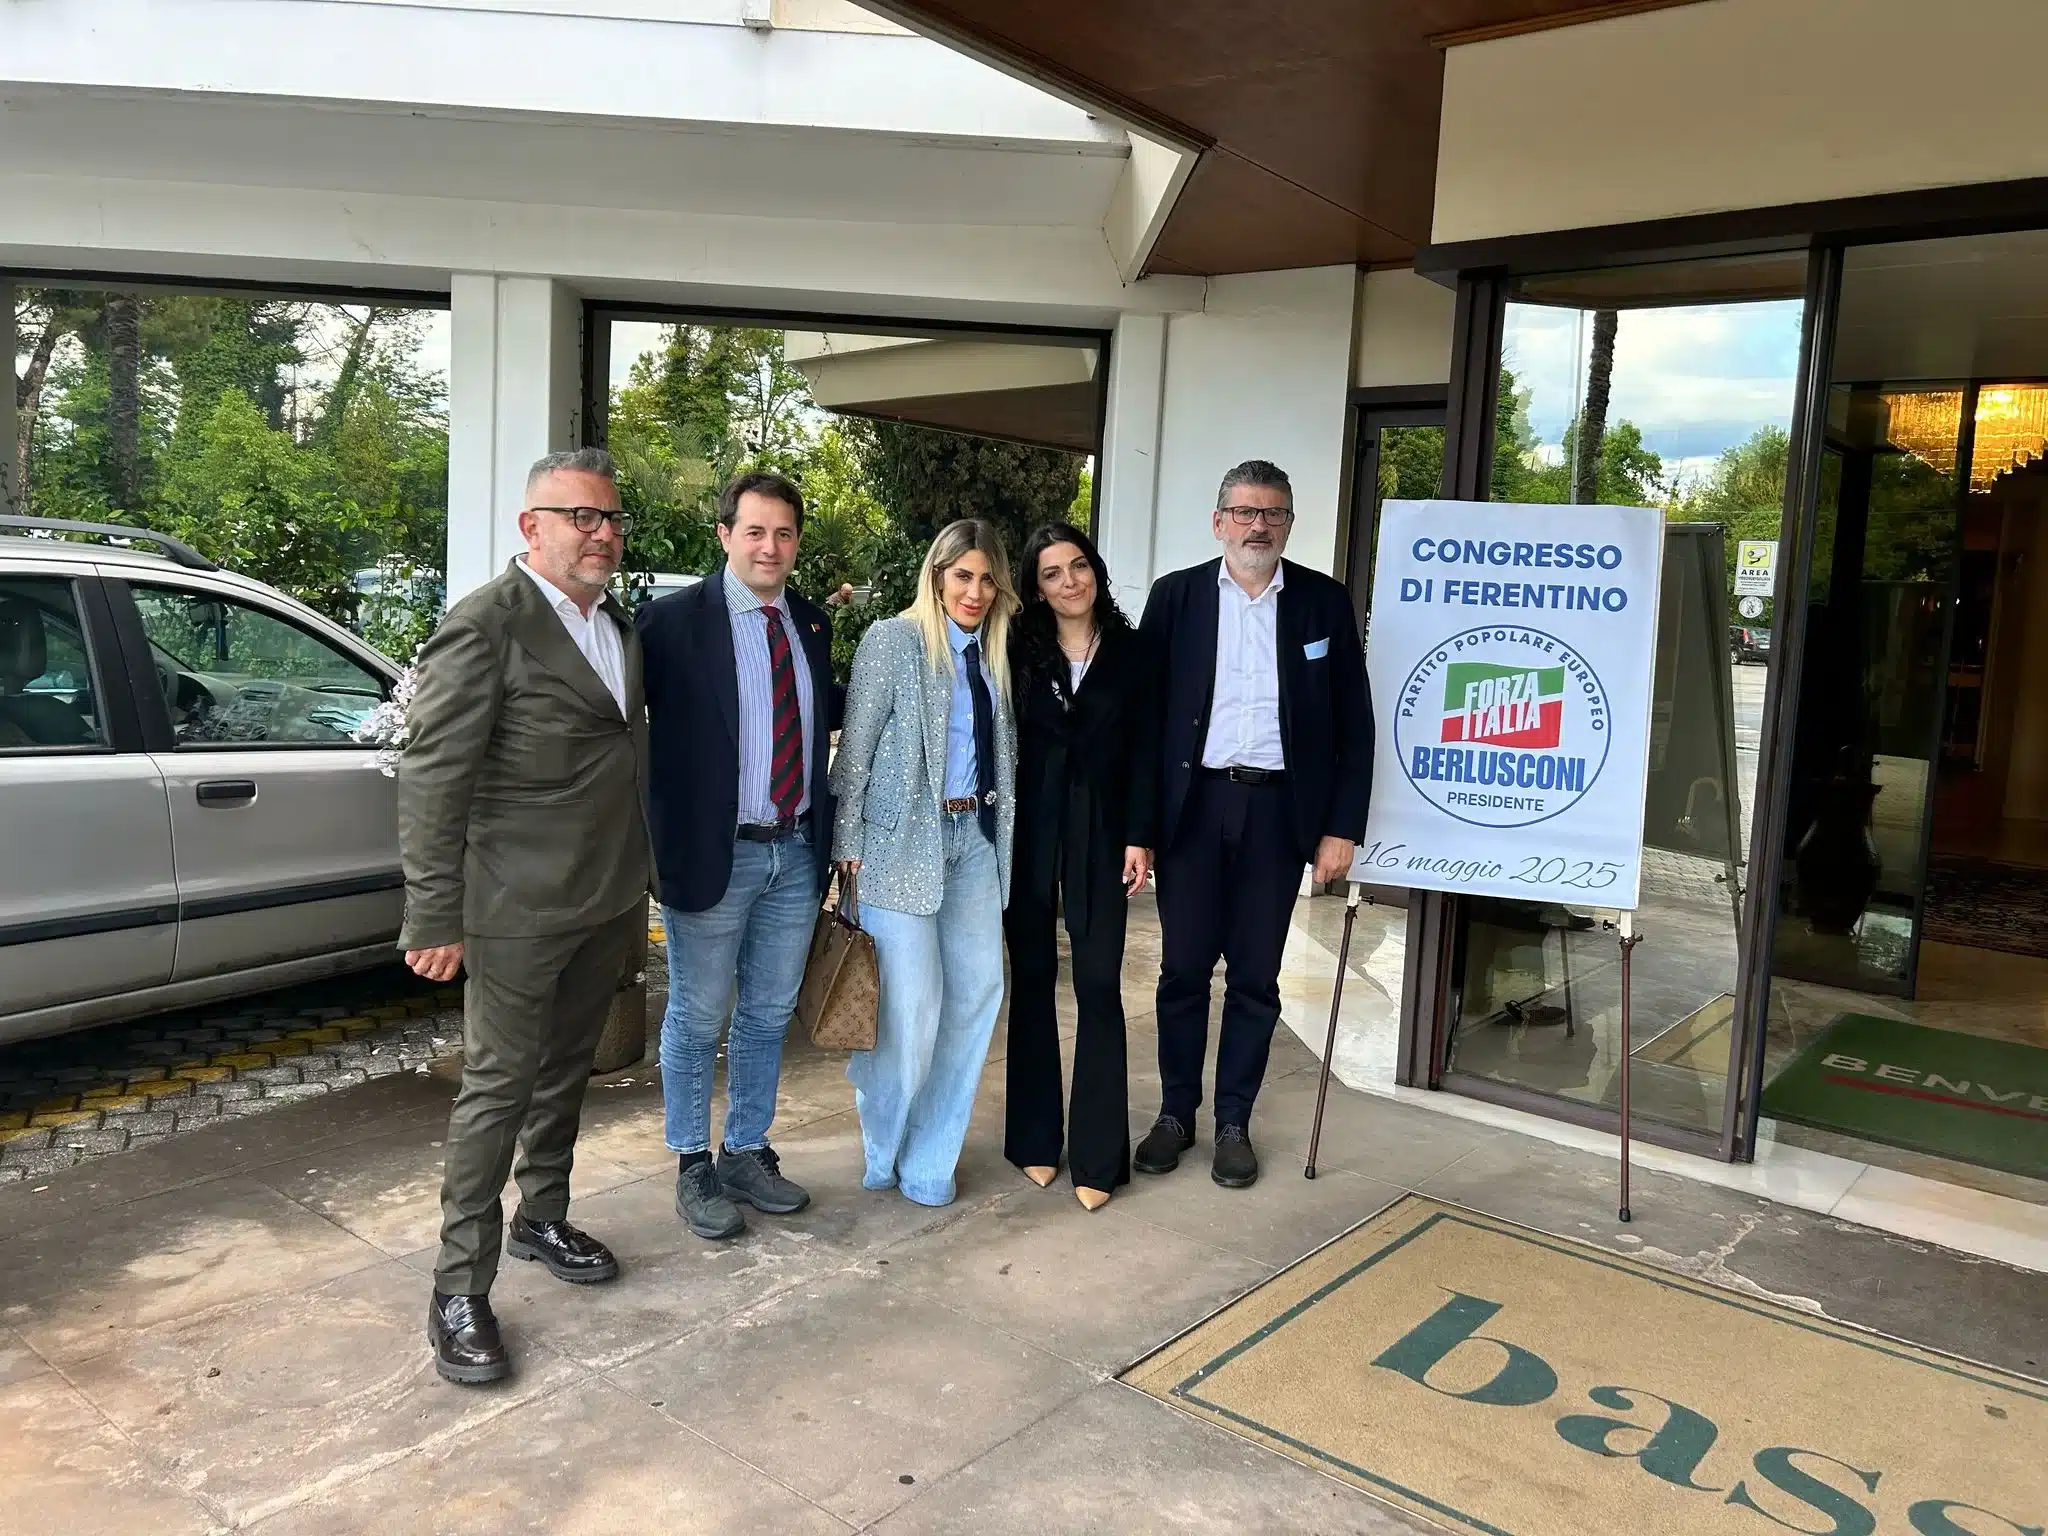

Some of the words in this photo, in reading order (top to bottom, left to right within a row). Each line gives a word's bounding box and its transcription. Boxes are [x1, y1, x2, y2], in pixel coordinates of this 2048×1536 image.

[1411, 537, 1622, 570] CONGRESSO
[1400, 578, 1433, 603] DI
[1443, 580, 1628, 613] FERENTINO
[1402, 649, 1449, 718] PARTITO
[1454, 629, 1555, 655] POPOLARE
[1558, 651, 1605, 732] EUROPEO
[1464, 671, 1540, 714] FORZA
[1461, 698, 1541, 741] ITALIA
[1411, 745, 1586, 792] BERLUSCONI
[1446, 791, 1545, 812] PRESIDENTE
[1360, 841, 1406, 867] 16
[1404, 856, 1503, 883] maggio
[1508, 856, 1626, 889] 2025
